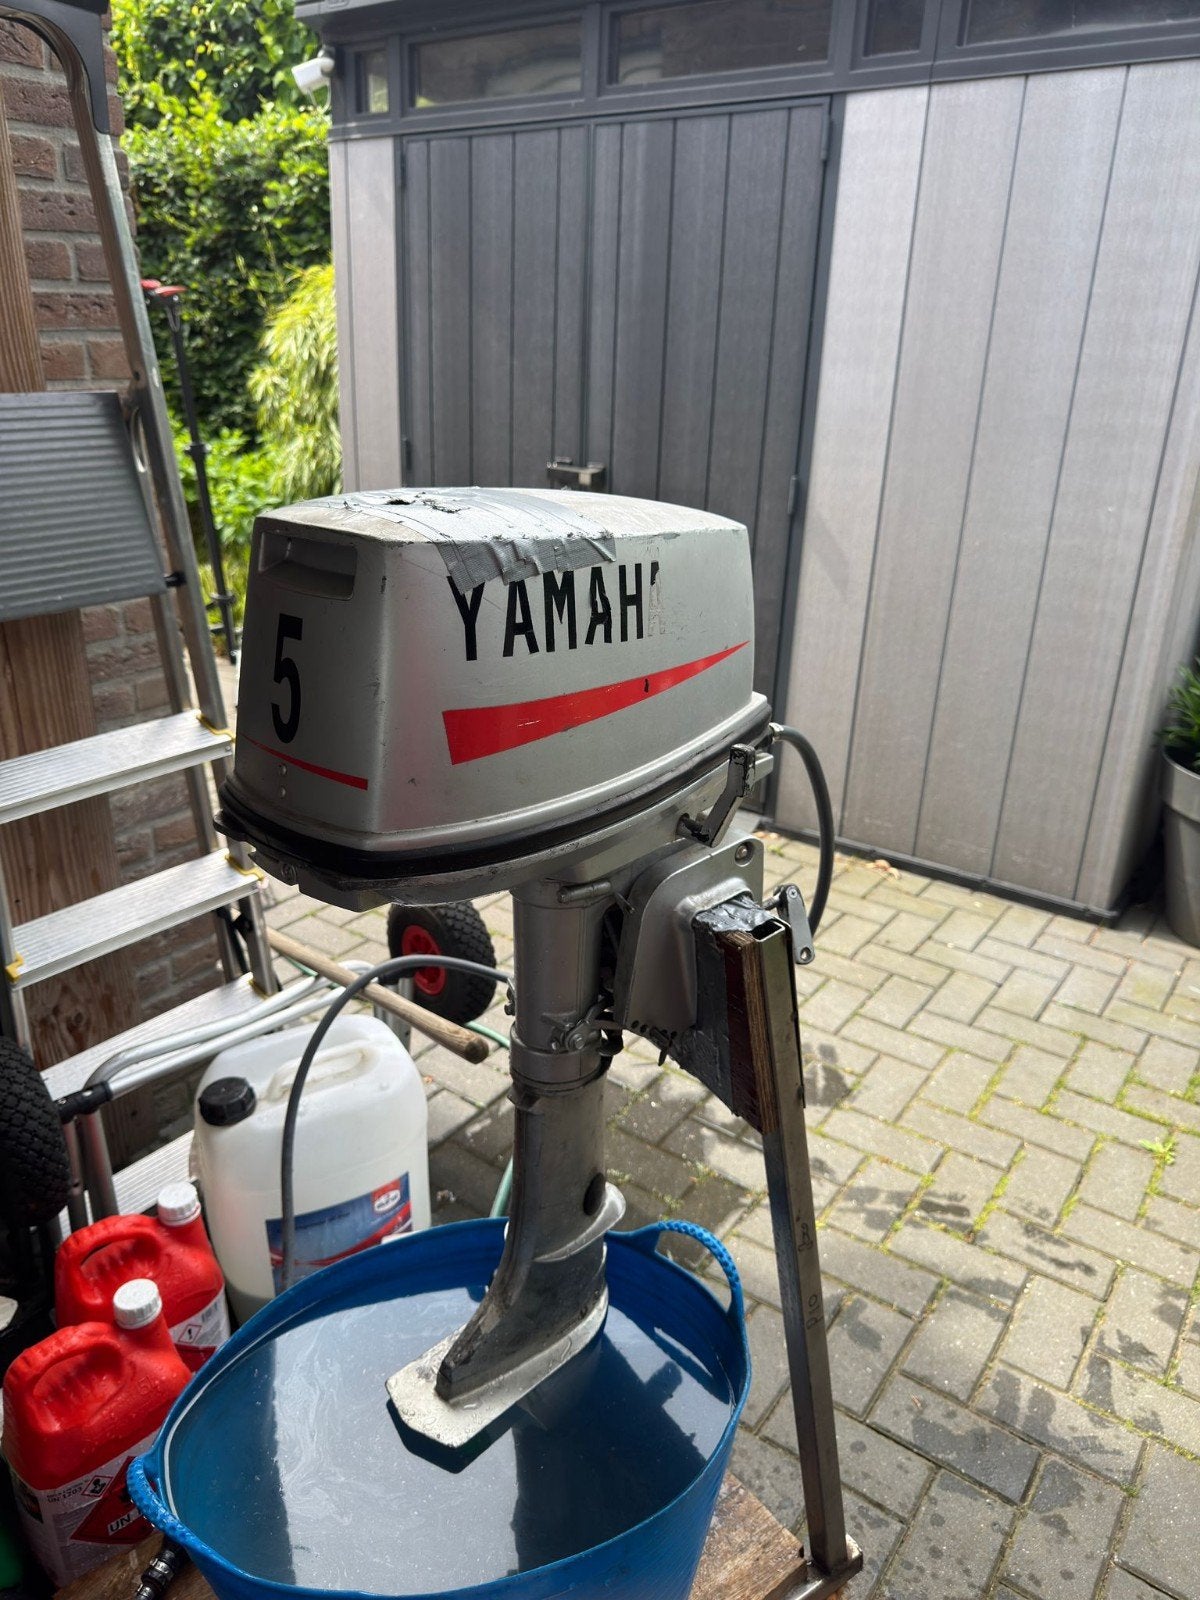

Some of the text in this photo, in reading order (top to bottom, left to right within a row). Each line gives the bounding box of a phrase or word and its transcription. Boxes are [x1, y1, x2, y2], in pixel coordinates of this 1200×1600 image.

[447, 560, 663, 661] YAMAH
[271, 613, 303, 743] 5
[109, 1513, 132, 1533] UN
